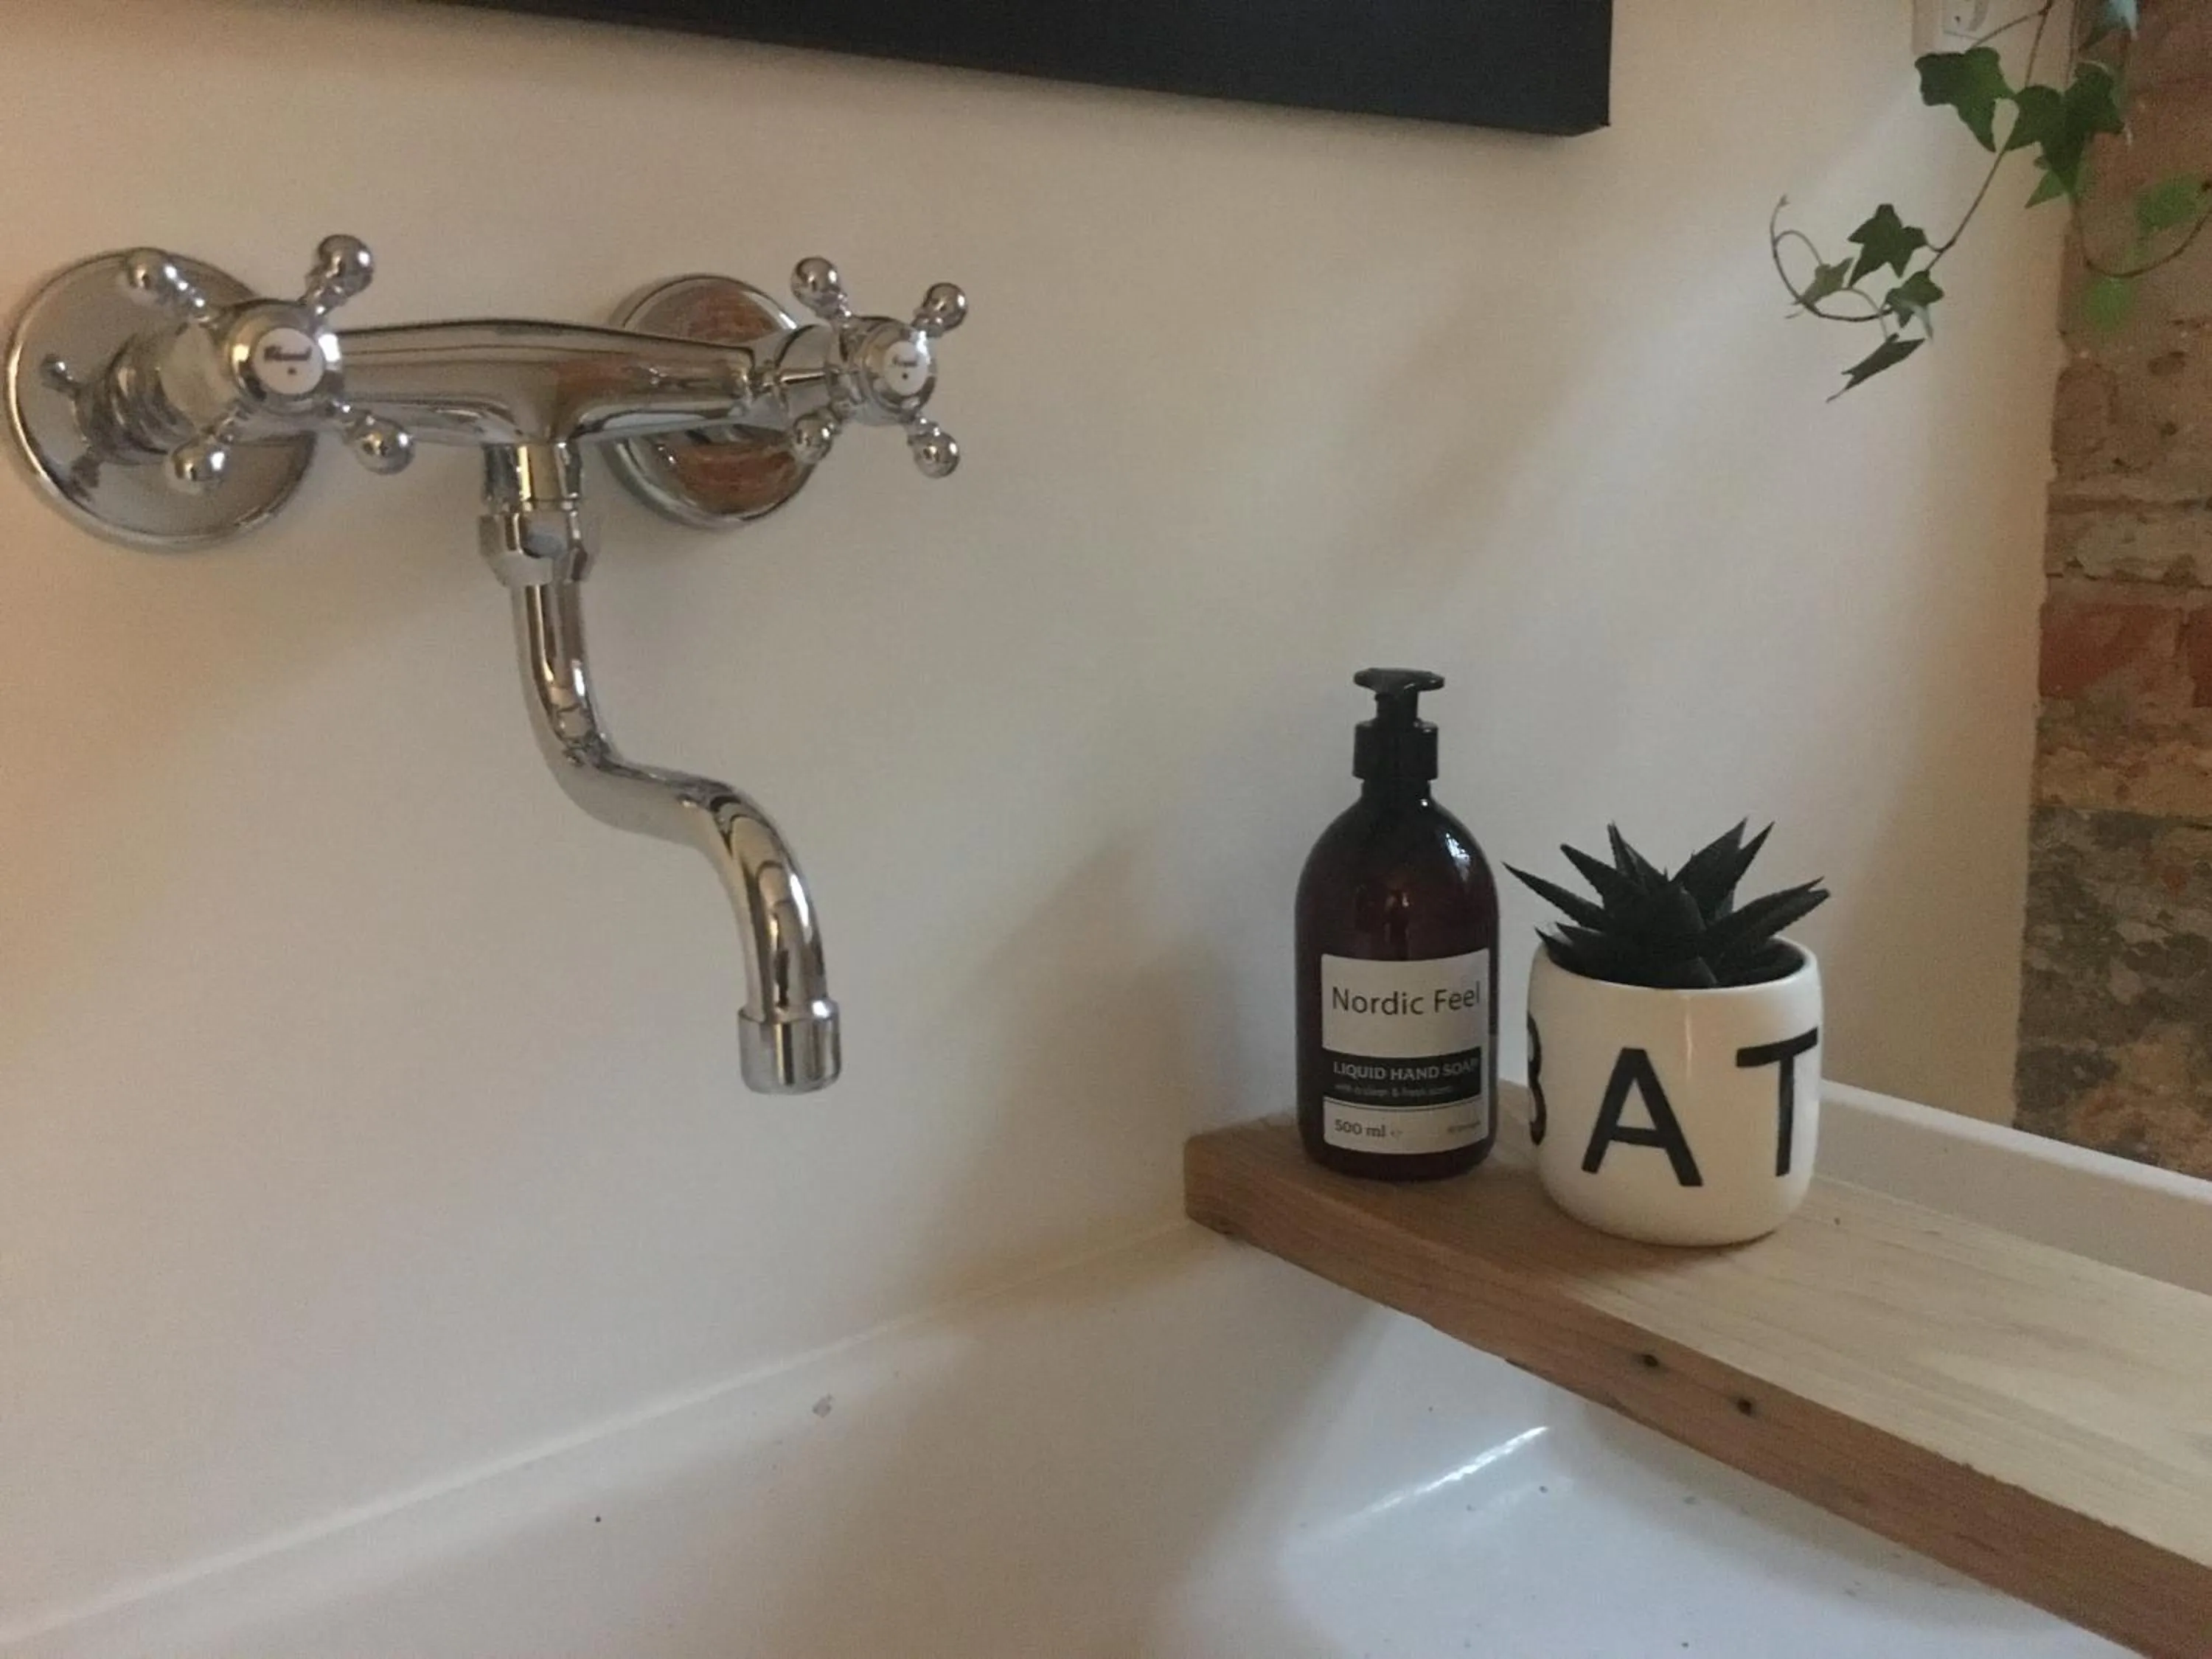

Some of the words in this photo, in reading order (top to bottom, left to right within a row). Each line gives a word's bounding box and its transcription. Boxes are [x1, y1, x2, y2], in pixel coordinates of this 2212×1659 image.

[1332, 986, 1424, 1016] Nordic
[1434, 981, 1480, 1013] Feel
[1333, 1060, 1387, 1081] LIQUID
[1391, 1065, 1439, 1082] HAND
[1335, 1119, 1363, 1135] 500
[1366, 1124, 1385, 1137] ml
